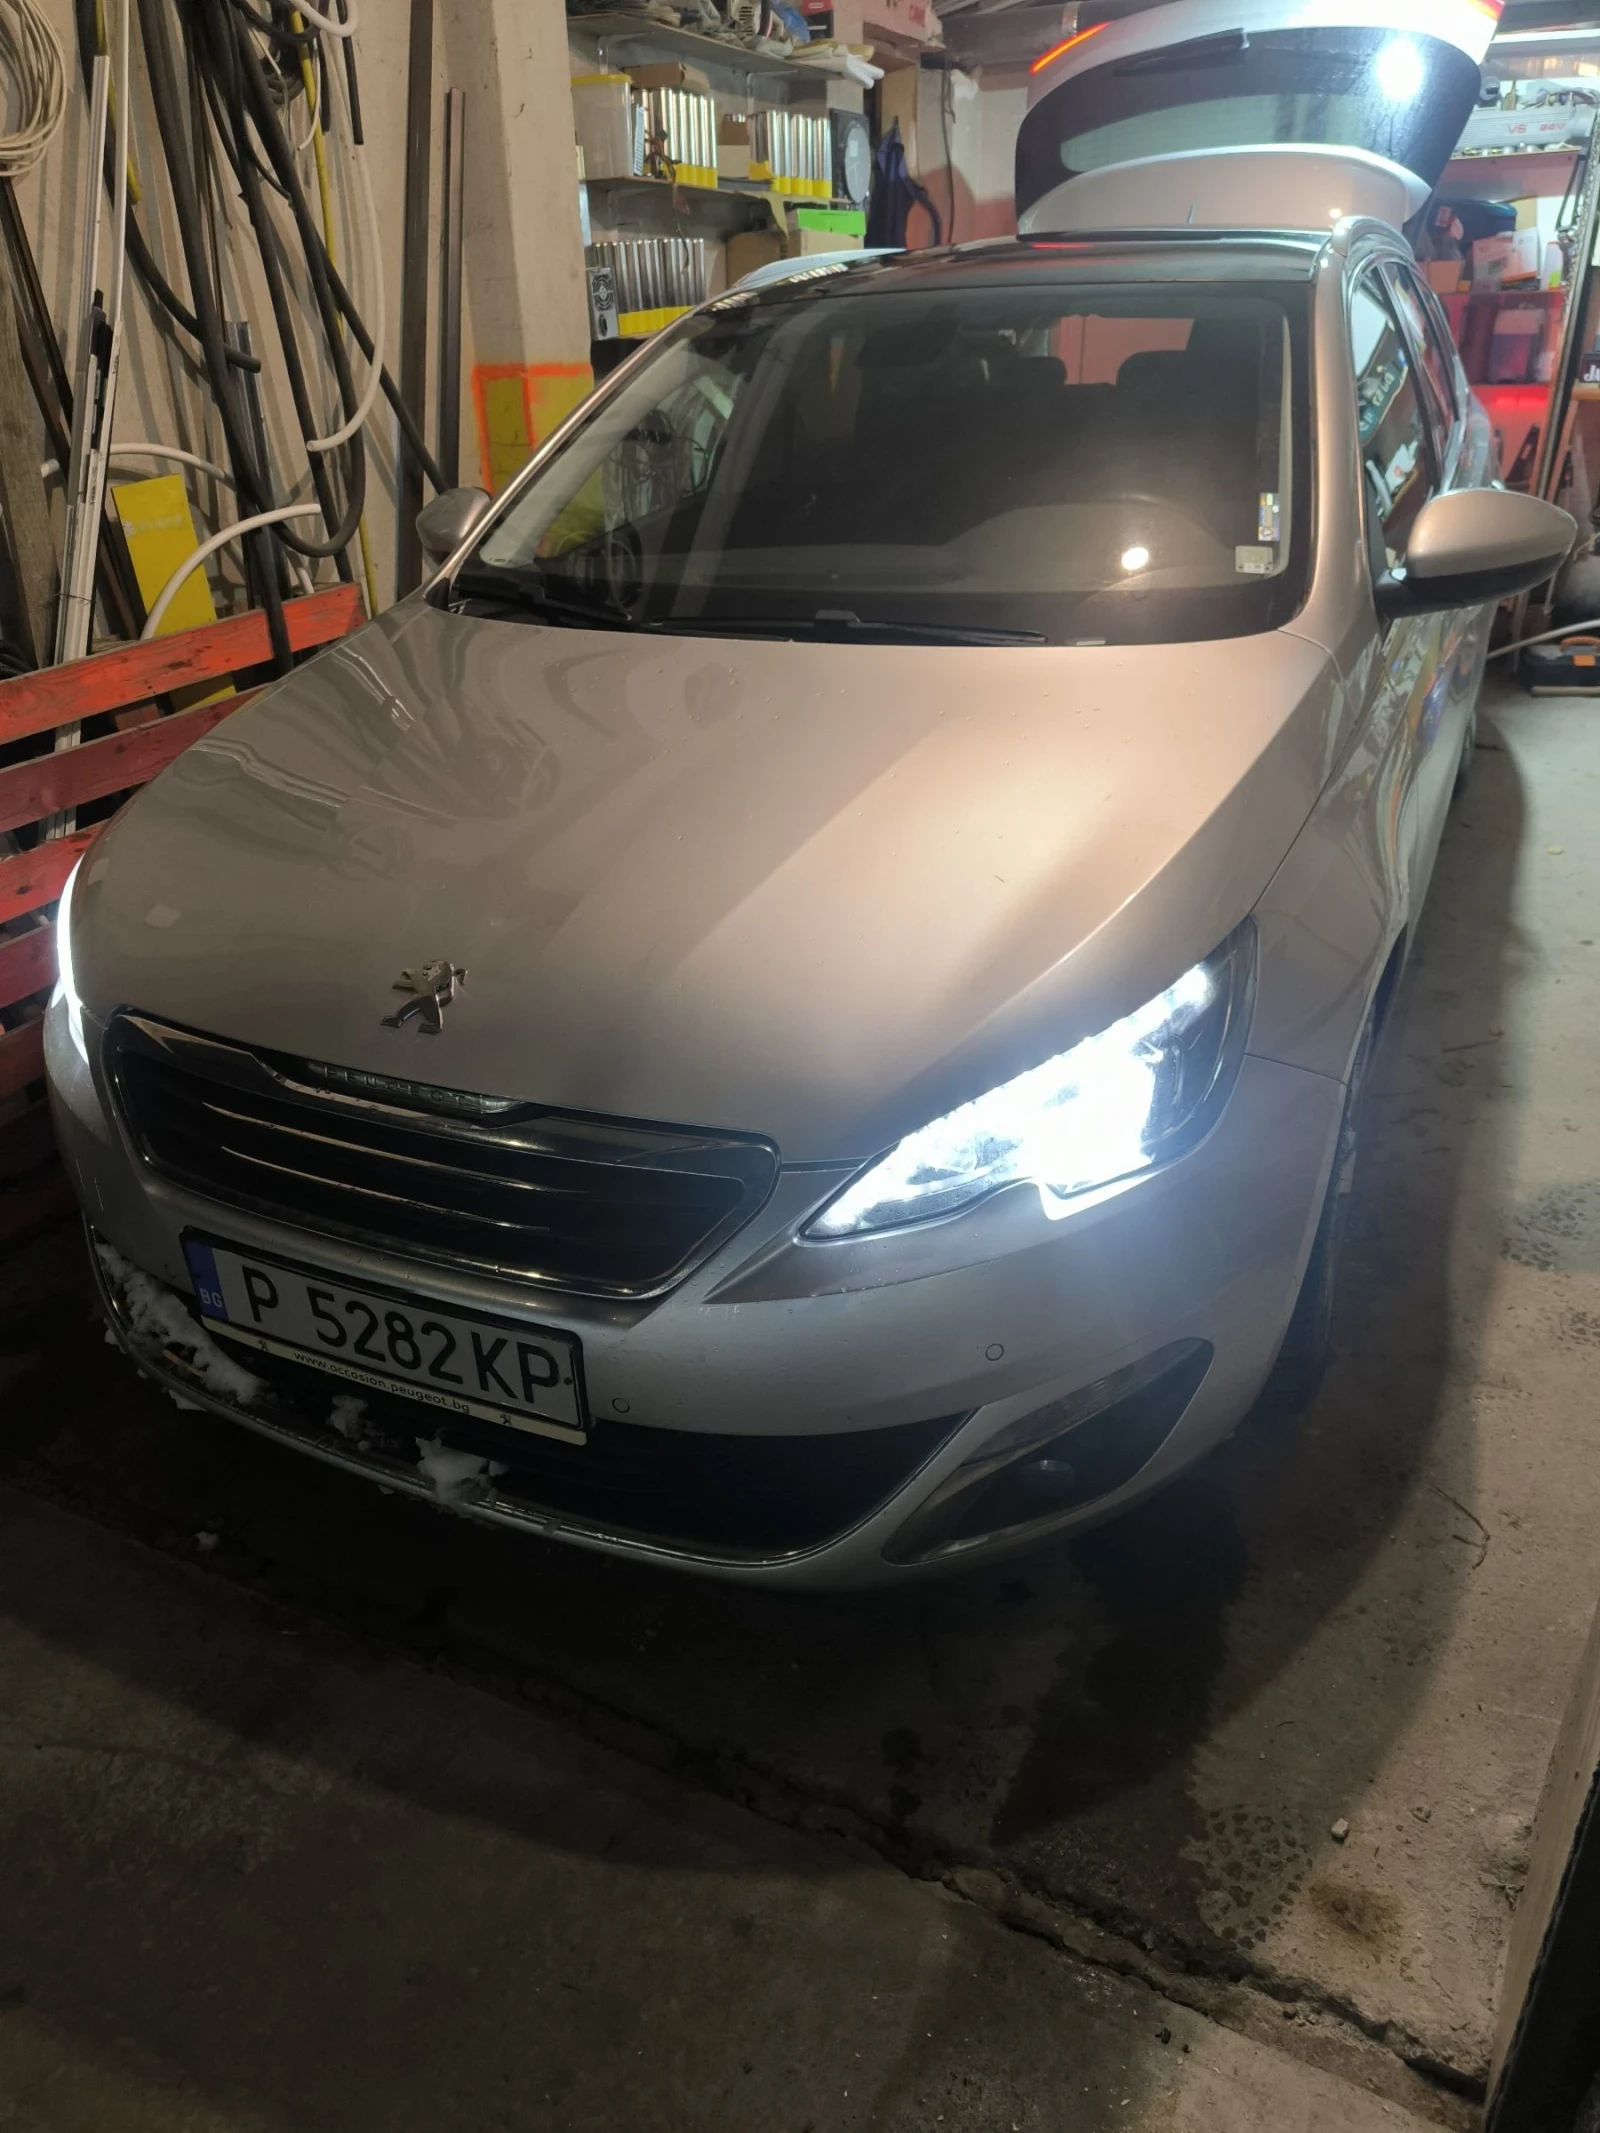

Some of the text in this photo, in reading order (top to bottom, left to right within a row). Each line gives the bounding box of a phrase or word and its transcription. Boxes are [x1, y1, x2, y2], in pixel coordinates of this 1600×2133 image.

[1507, 124, 1527, 134] V6
[199, 1288, 222, 1308] BG
[306, 1286, 464, 1385] 5282
[293, 1352, 471, 1414] www.occasion.peugeot.bg
